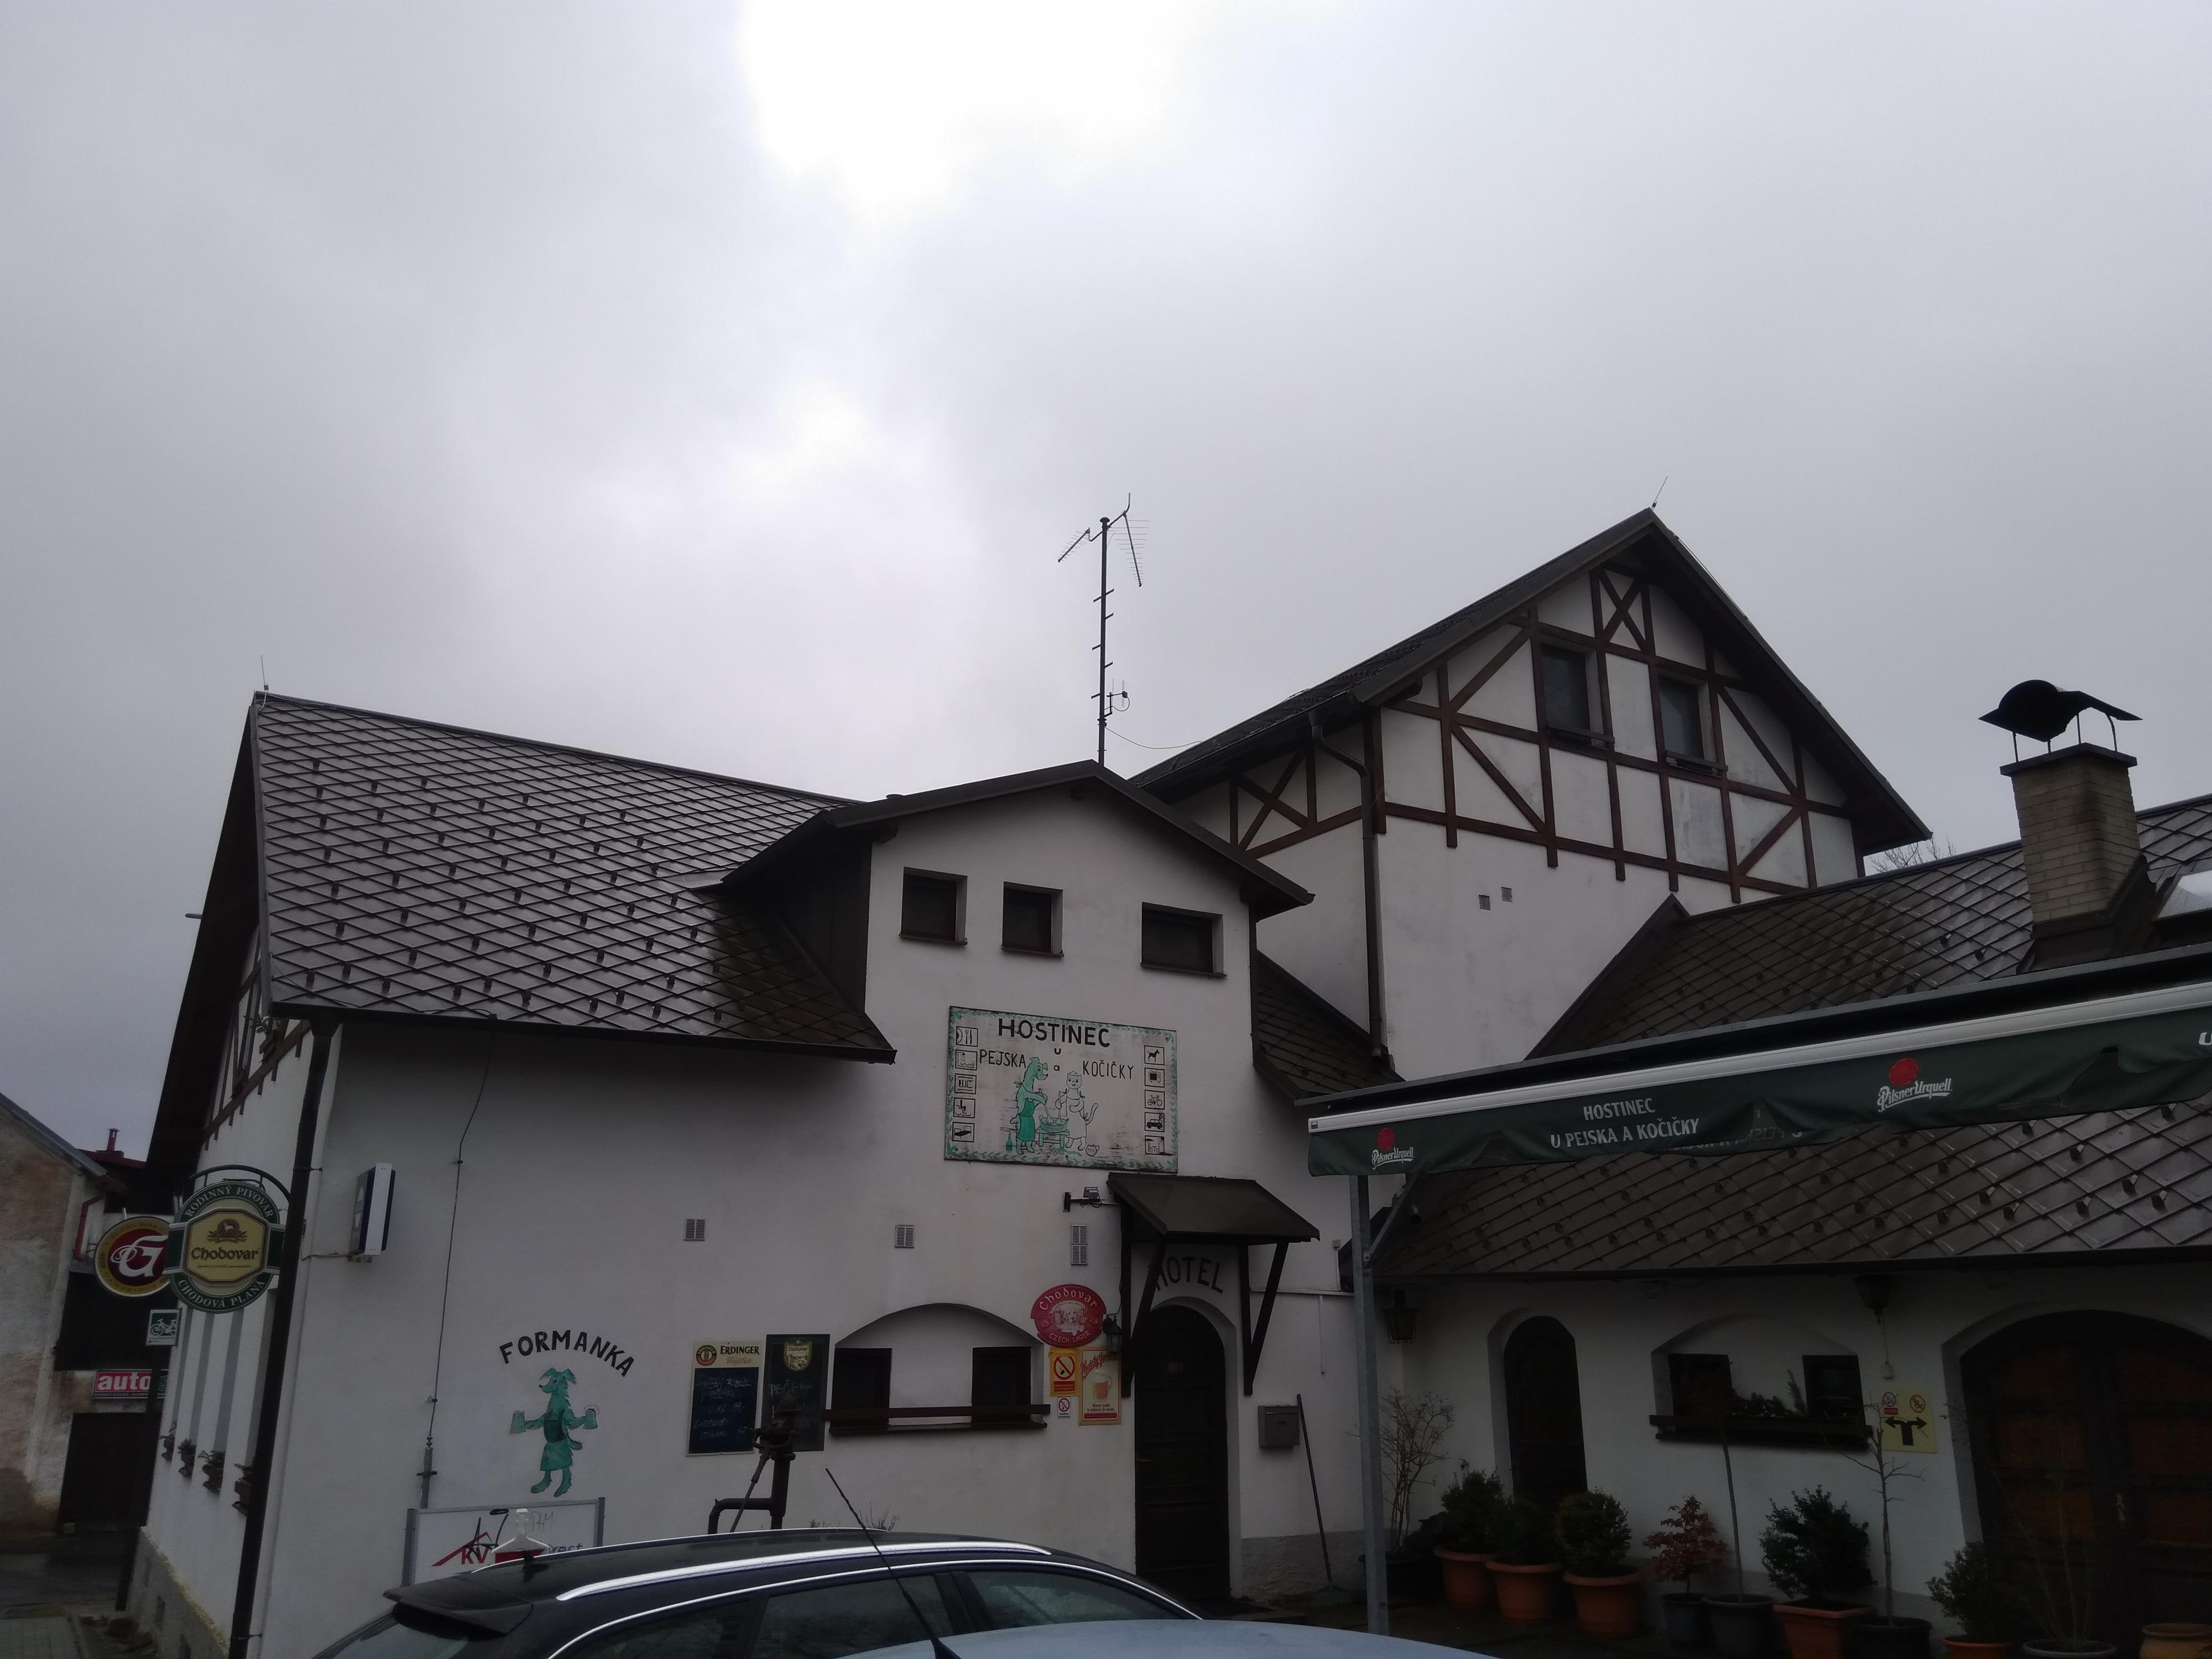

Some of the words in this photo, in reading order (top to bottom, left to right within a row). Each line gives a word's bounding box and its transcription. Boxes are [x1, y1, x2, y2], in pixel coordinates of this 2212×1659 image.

[998, 1018, 1110, 1047] HOSTINEC
[979, 1049, 1026, 1068] PEJSKA
[1083, 1060, 1134, 1080] KOČIČKY
[1876, 1086, 1915, 1113] Pilsner
[1914, 1078, 1952, 1099] Urquell
[1583, 1097, 1656, 1121] HOSTINEC
[1550, 1134, 1560, 1149] U
[1565, 1128, 1619, 1147] PEJSKA
[1623, 1126, 1634, 1142] A
[1636, 1116, 1699, 1140] KOČIČKY
[1371, 1149, 1394, 1170] Pilsner
[1393, 1146, 1413, 1164] Urquell
[185, 1185, 232, 1217] RODINNÝ
[236, 1186, 274, 1217] PIVOVAR
[191, 1246, 258, 1261] Chodovar
[178, 1279, 226, 1308] CHODOVÁ
[1039, 1287, 1098, 1311] Chodovar
[1048, 1333, 1070, 1343] CZECH
[1073, 1330, 1092, 1342] LAGER
[499, 1329, 635, 1378] FORMANKA
[720, 1345, 760, 1355] ERDINGER
[97, 1371, 152, 1390] auto
